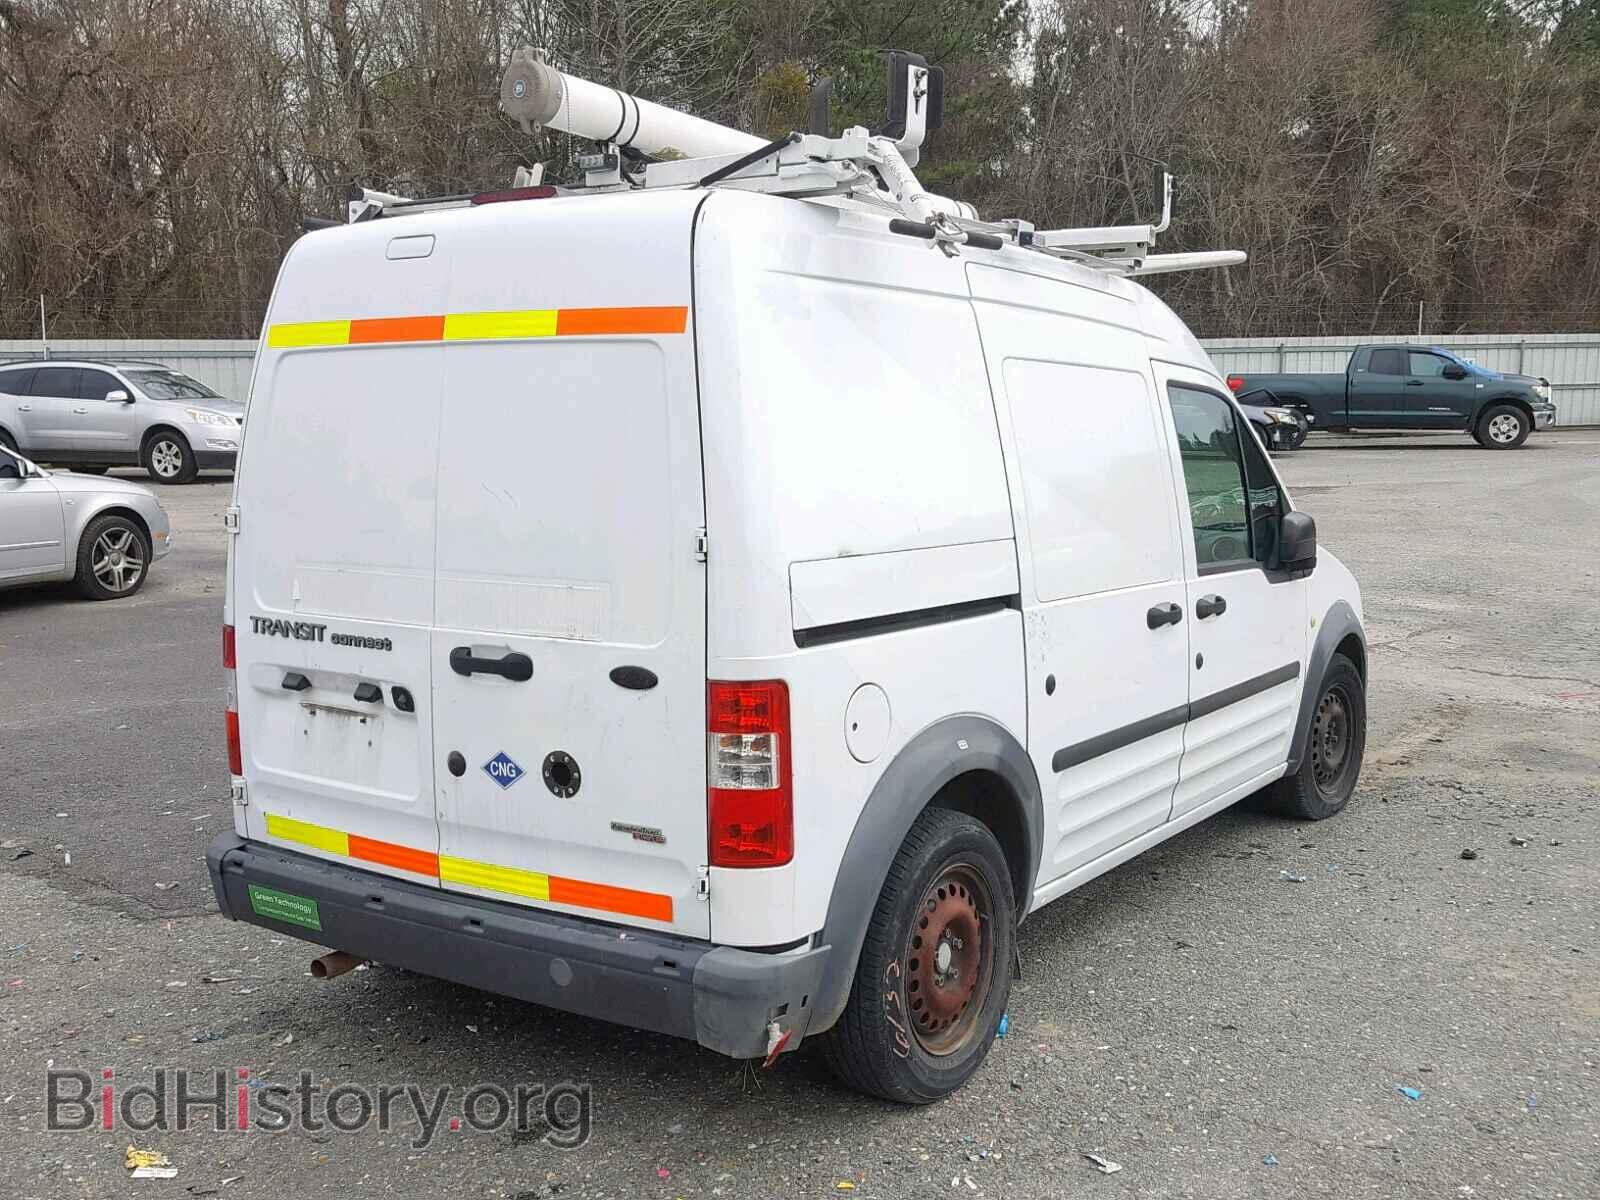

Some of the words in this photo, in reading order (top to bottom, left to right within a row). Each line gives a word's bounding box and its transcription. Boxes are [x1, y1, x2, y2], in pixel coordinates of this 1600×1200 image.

[250, 616, 327, 642] TRANSIT
[490, 761, 516, 778] CNG
[254, 892, 274, 903] Green
[273, 896, 312, 914] Technology
